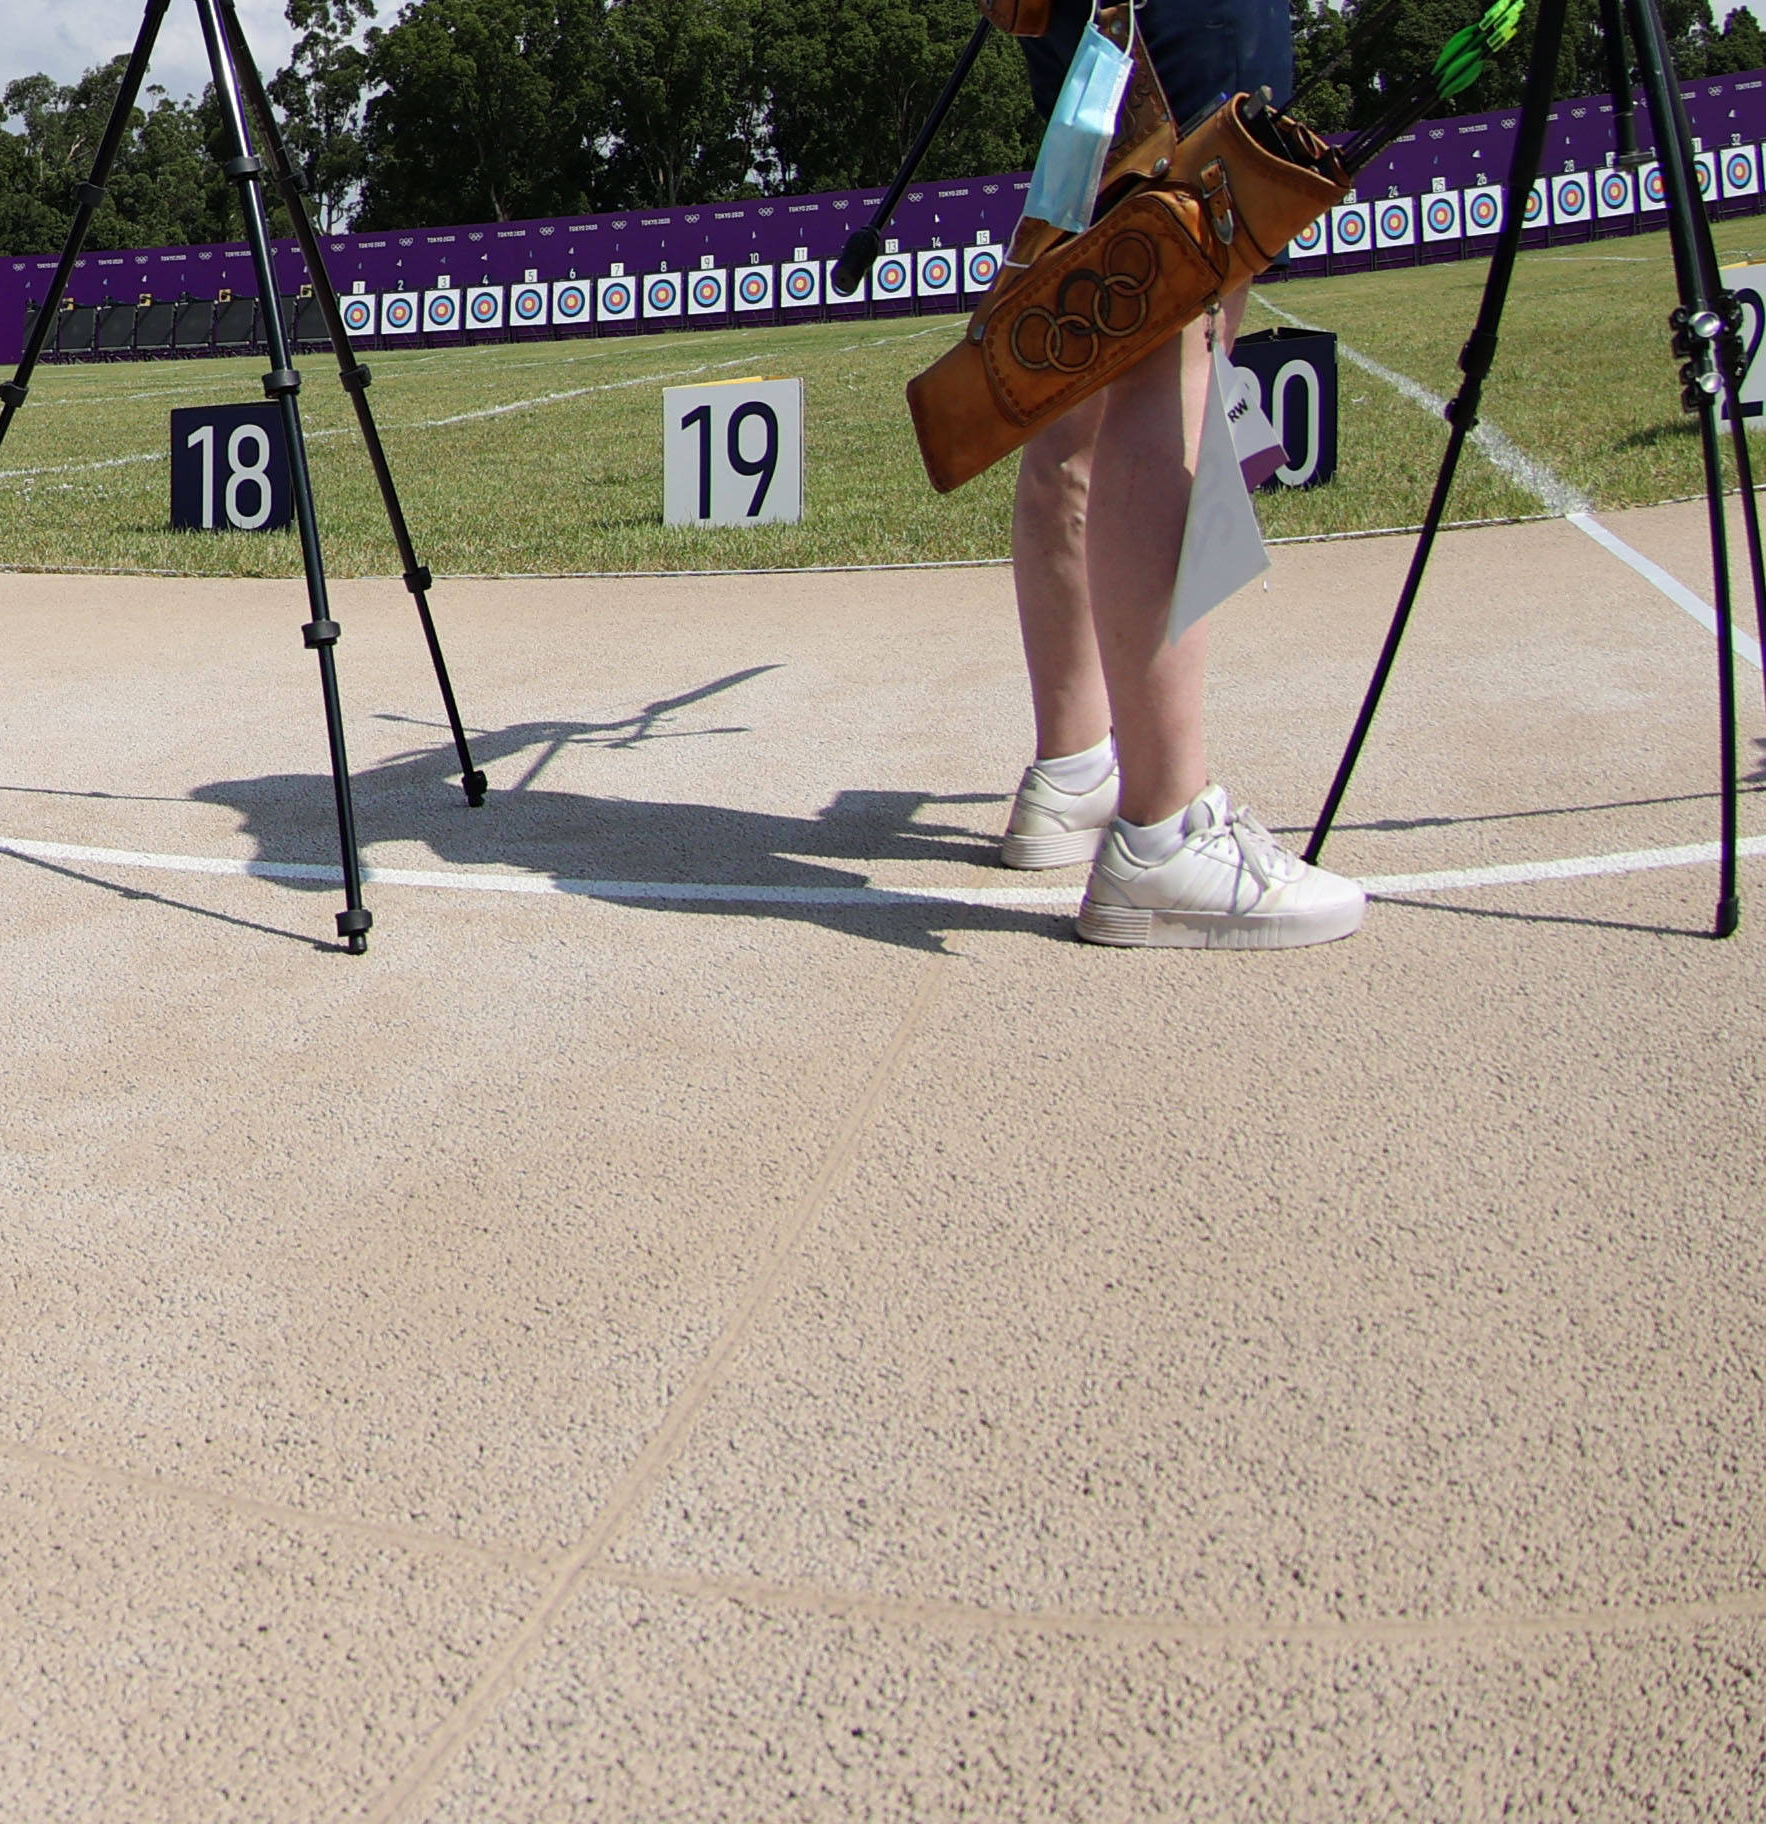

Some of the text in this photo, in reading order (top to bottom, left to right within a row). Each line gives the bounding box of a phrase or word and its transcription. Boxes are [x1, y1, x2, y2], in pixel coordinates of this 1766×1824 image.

[1388, 186, 1399, 198] 24
[932, 236, 942, 248] 14
[704, 257, 710, 268] 9
[749, 253, 760, 264] 10
[614, 265, 620, 275] 7
[661, 261, 667, 272] 8
[528, 271, 534, 281] 5
[569, 268, 576, 279] 6
[397, 280, 404, 290] 2
[441, 277, 447, 287] 3
[482, 274, 489, 285] 4
[1226, 398, 1250, 424] RW
[680, 400, 780, 519] 19
[186, 425, 271, 530] 18
